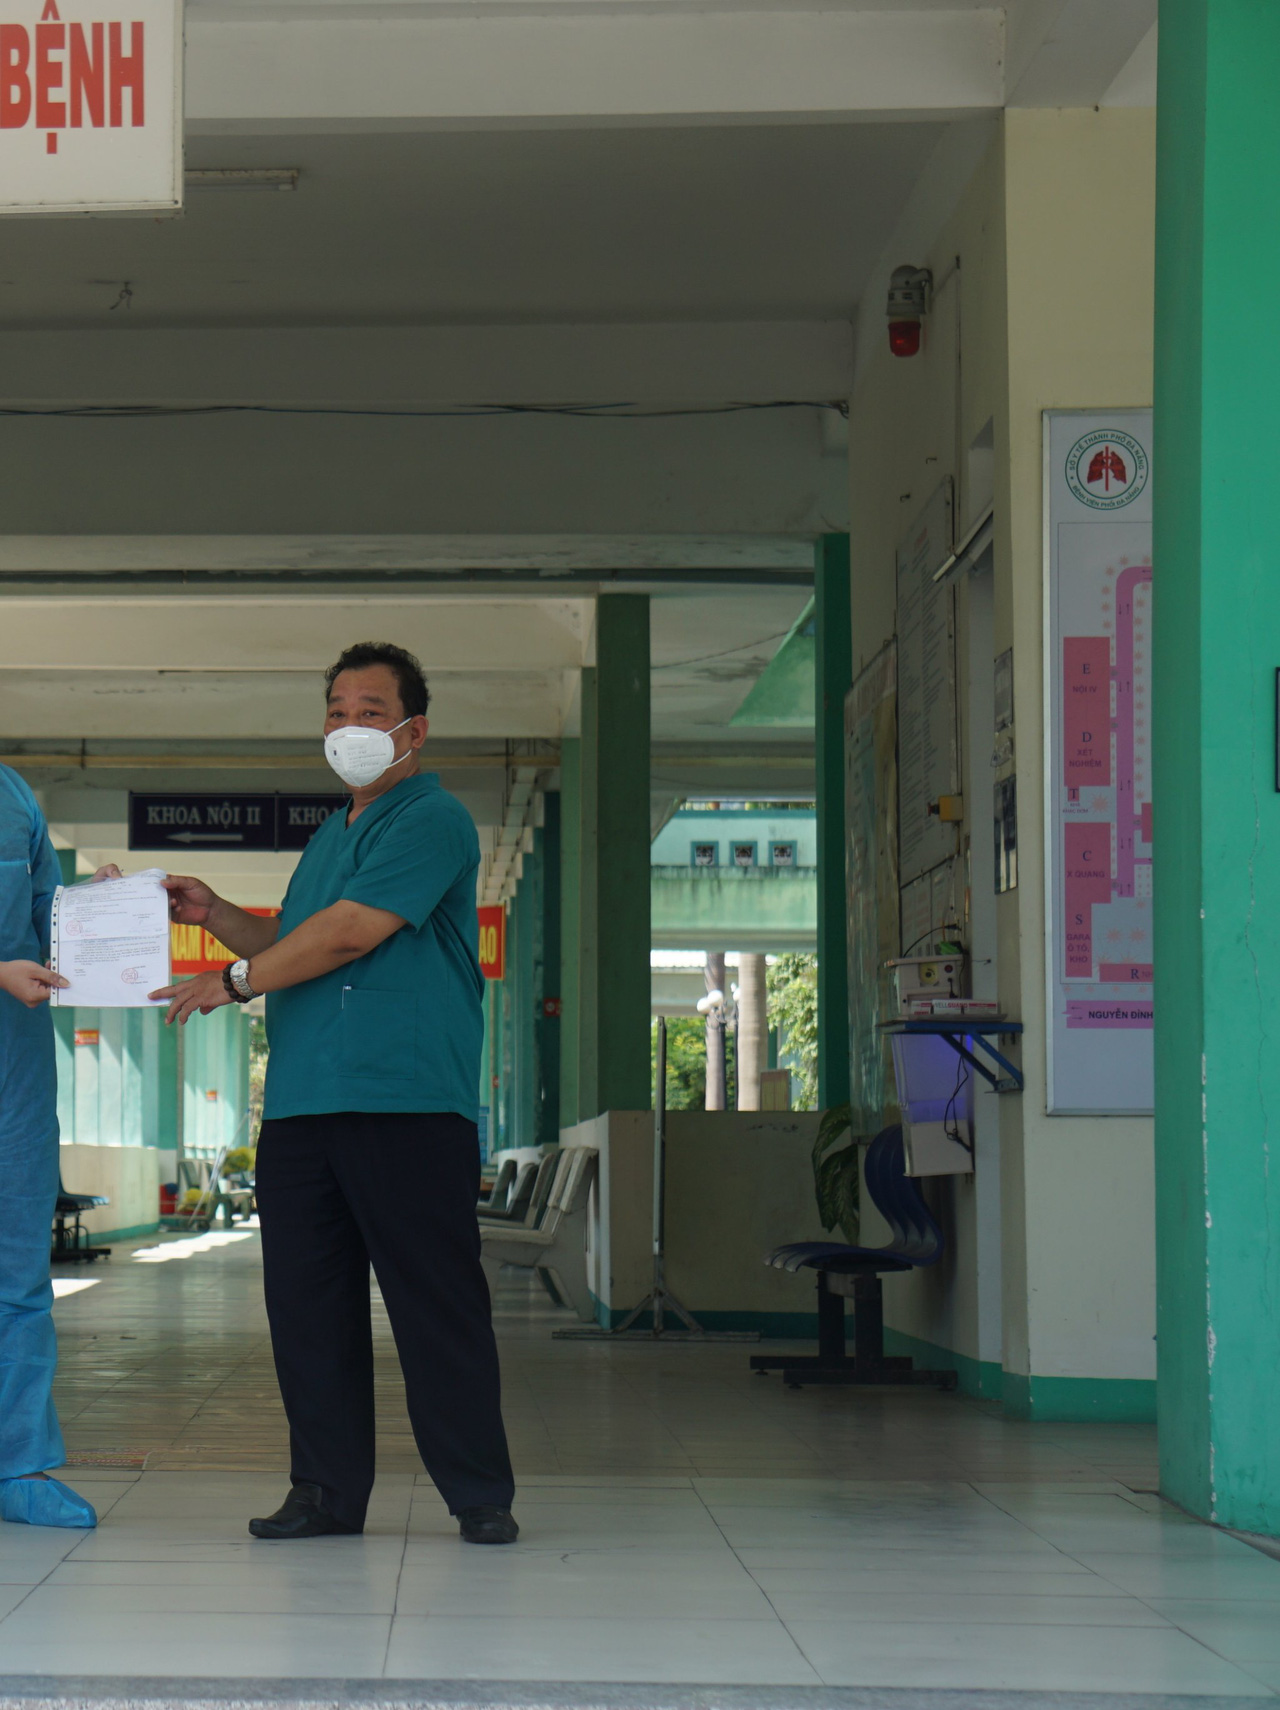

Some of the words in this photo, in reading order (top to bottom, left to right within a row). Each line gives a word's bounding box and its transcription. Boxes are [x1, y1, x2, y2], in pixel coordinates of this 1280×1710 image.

[1081, 663, 1091, 675] E
[1081, 731, 1092, 743] D
[1070, 788, 1079, 800] T
[146, 806, 201, 825] KHOA
[206, 802, 241, 829] NỘI
[246, 807, 261, 825] II
[288, 806, 339, 825] KHO
[1082, 850, 1092, 862] C
[1067, 870, 1074, 879] X
[1075, 870, 1105, 880] QUANG
[1075, 914, 1083, 926] S
[1069, 955, 1088, 964] KHO
[1131, 968, 1140, 980] R
[1088, 1007, 1128, 1020] NGUYỄN
